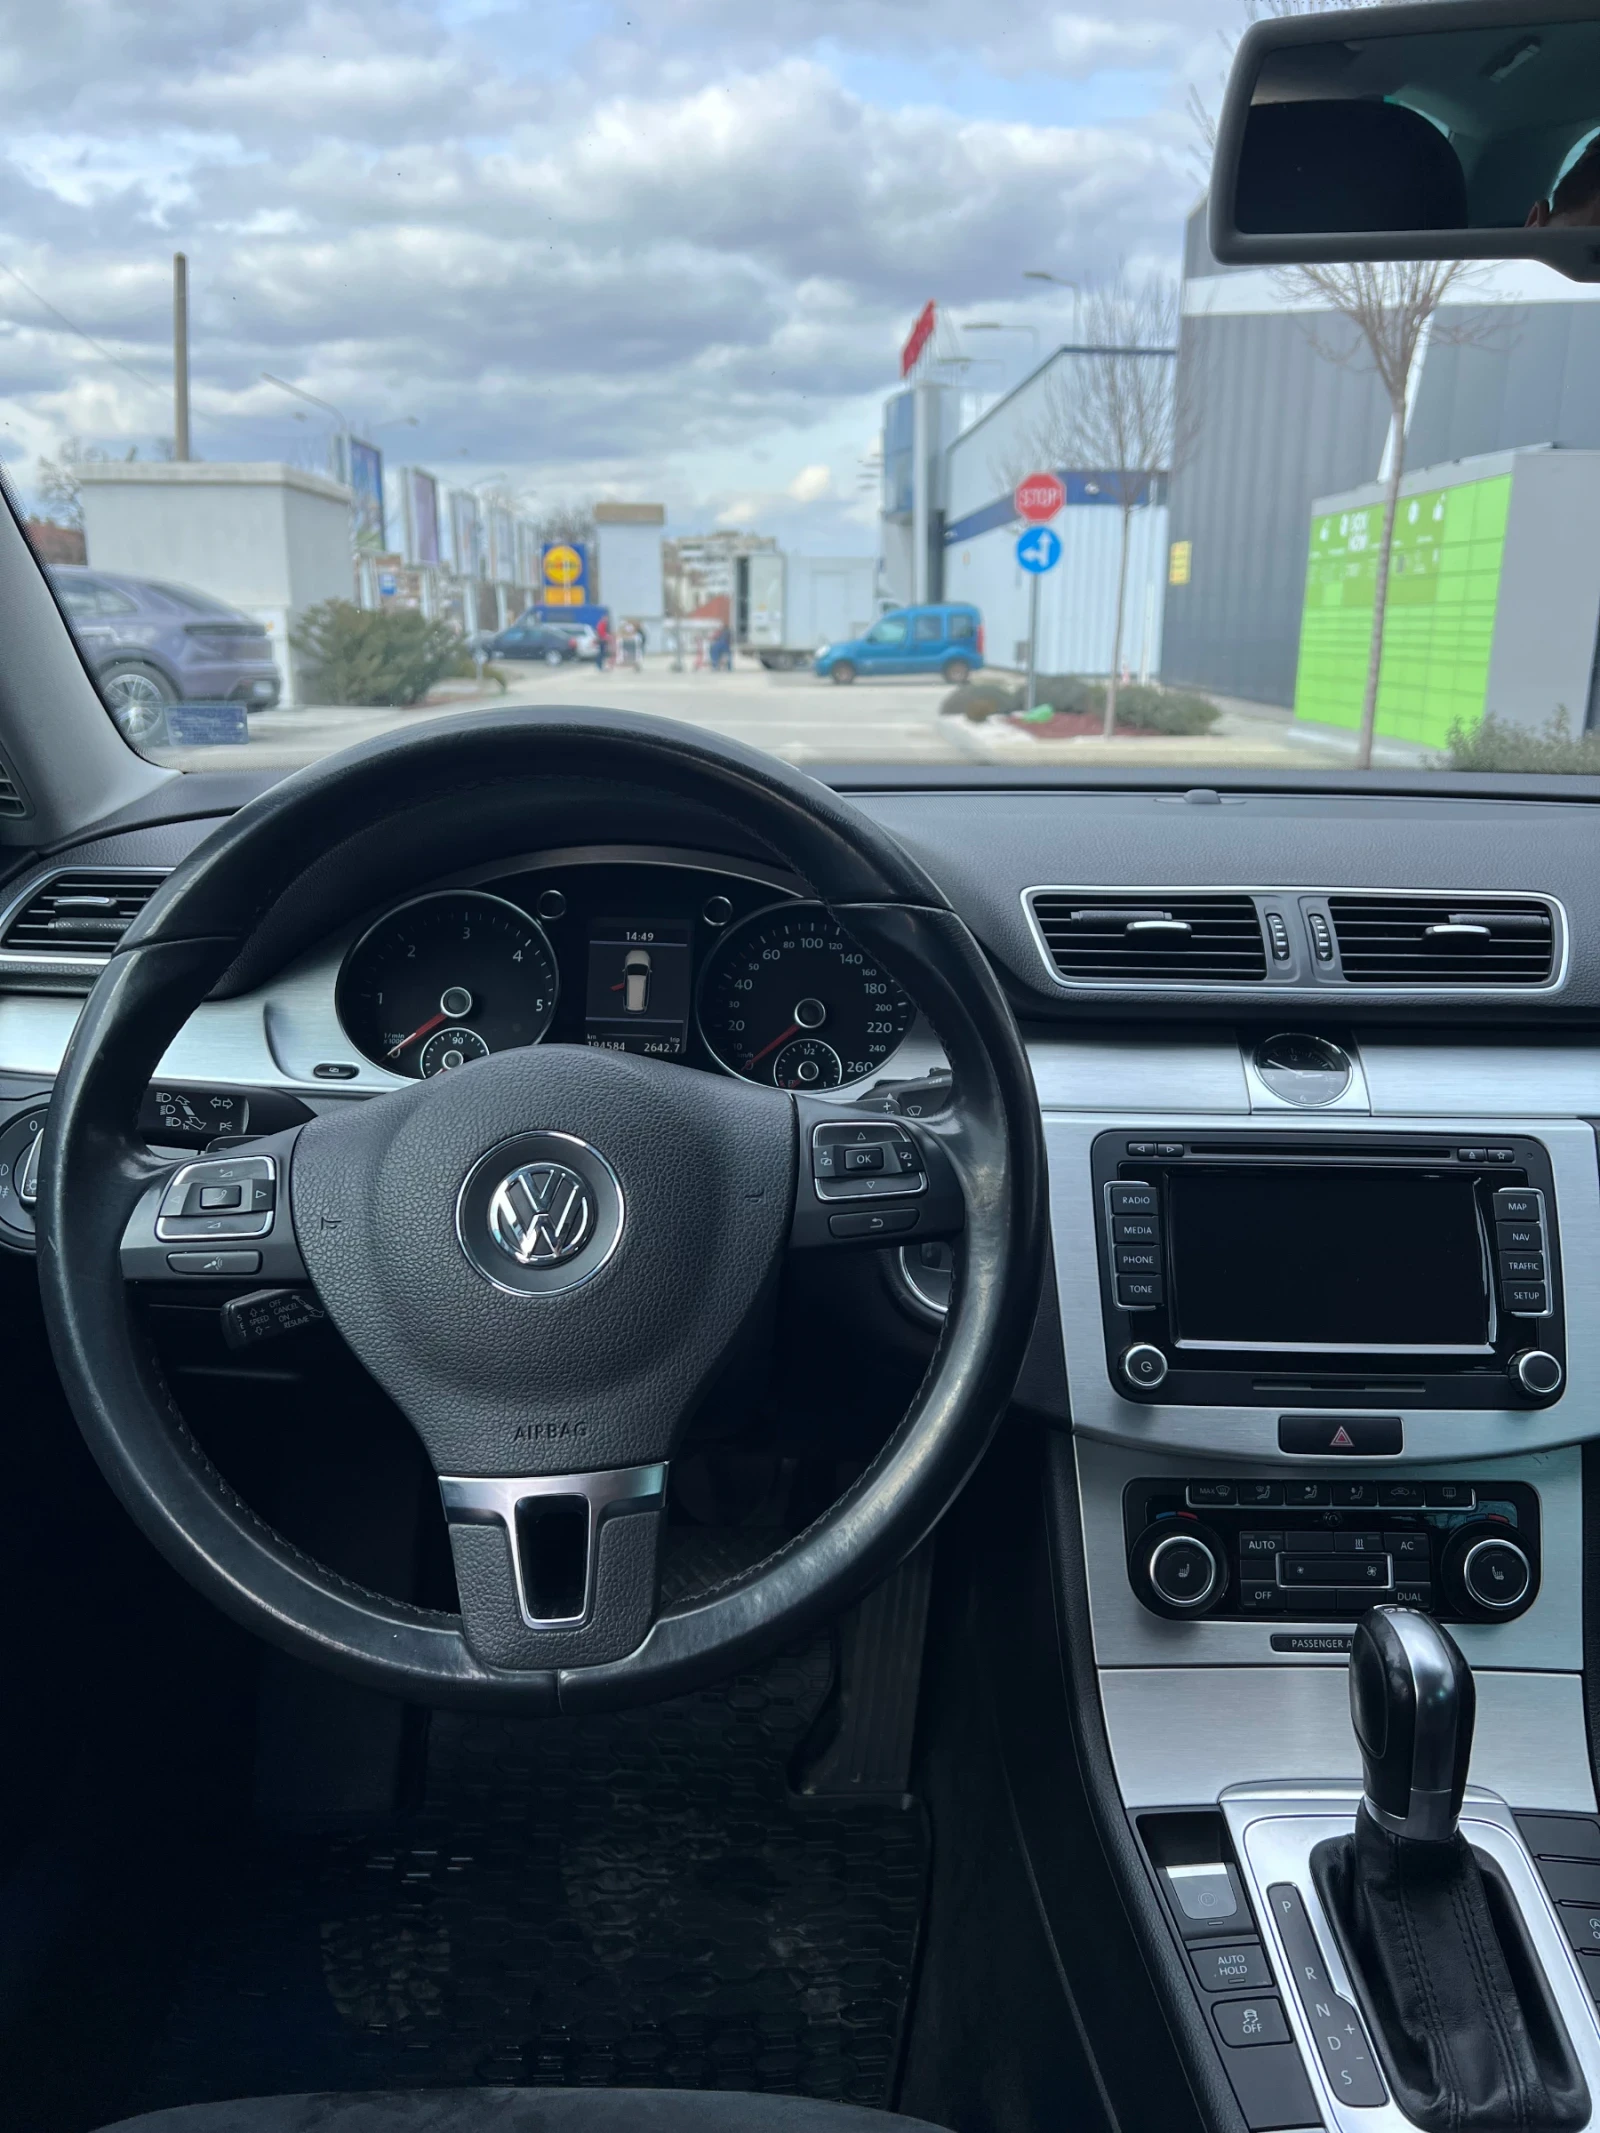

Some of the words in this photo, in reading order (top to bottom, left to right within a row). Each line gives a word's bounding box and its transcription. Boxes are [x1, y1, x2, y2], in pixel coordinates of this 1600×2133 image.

[1019, 487, 1058, 507] STOP
[462, 926, 471, 939] 3
[626, 931, 654, 941] 14:49
[783, 941, 795, 949] 80
[801, 937, 824, 949] 100
[828, 942, 843, 951] 120
[407, 945, 416, 958] 2
[512, 949, 523, 962] 4
[762, 949, 780, 961] 60
[840, 953, 864, 965] 140
[748, 963, 760, 971] 50
[861, 968, 877, 977] 160
[734, 979, 753, 991] 40
[864, 983, 887, 995] 180
[376, 992, 384, 1005] 1
[535, 999, 544, 1012] 5
[728, 1000, 740, 1009] 30
[875, 1003, 893, 1012] 200
[728, 1019, 745, 1032] 20
[866, 1021, 893, 1034] 220
[452, 1036, 464, 1045] 90
[643, 1042, 681, 1053] 2642.7
[733, 1043, 743, 1051] 10
[868, 1044, 886, 1053] 240
[847, 1061, 874, 1073] 260
[856, 1154, 872, 1164] OK
[1122, 1196, 1150, 1205] RADIO
[1508, 1202, 1527, 1211] MAP
[1124, 1226, 1152, 1235] MEDIA
[1512, 1233, 1530, 1241] NAV
[1123, 1255, 1154, 1264] PHONE
[1509, 1262, 1539, 1271] TRAFFIC
[1129, 1285, 1153, 1294] TONE
[1513, 1292, 1540, 1300] SETUP
[269, 1299, 282, 1308] OFF
[273, 1303, 299, 1315] CANCEL
[249, 1315, 270, 1326] SPEED
[278, 1314, 290, 1322] ON
[283, 1316, 310, 1329] RESUME
[514, 1420, 588, 1441] AIRBAG
[1200, 1487, 1215, 1495] MAX
[1248, 1541, 1276, 1550] AUTO
[1400, 1542, 1414, 1550] AC
[1254, 1591, 1272, 1600] OFF
[1397, 1592, 1422, 1601] DUAL
[1291, 1639, 1344, 1649] PASSENGER
[1282, 1901, 1292, 1914] P
[1218, 1954, 1246, 1965] AUTO
[1219, 1964, 1248, 1976] HOLD
[1305, 1966, 1318, 1981] R
[1316, 2003, 1331, 2018] N
[1242, 2023, 1263, 2034] OFF
[1328, 2036, 1342, 2051] D
[1341, 2070, 1352, 2085] S
